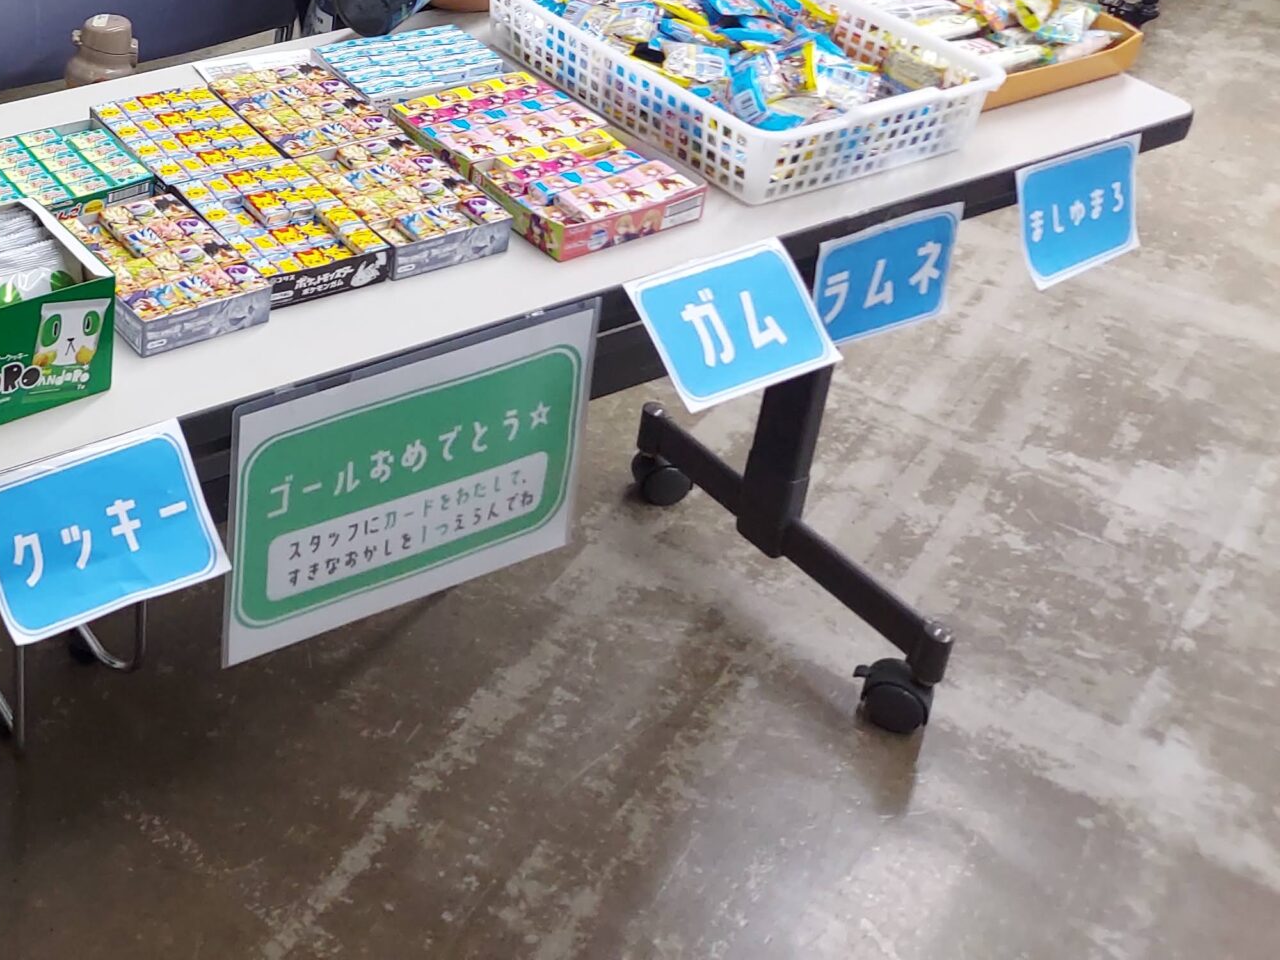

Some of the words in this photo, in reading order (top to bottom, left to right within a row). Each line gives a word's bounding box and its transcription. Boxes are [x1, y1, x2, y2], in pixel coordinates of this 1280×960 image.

[1027, 179, 1126, 244] ましゅまろ
[821, 240, 943, 327] ラムネ
[679, 286, 789, 368] ガム
[12, 498, 188, 589] クッキー
